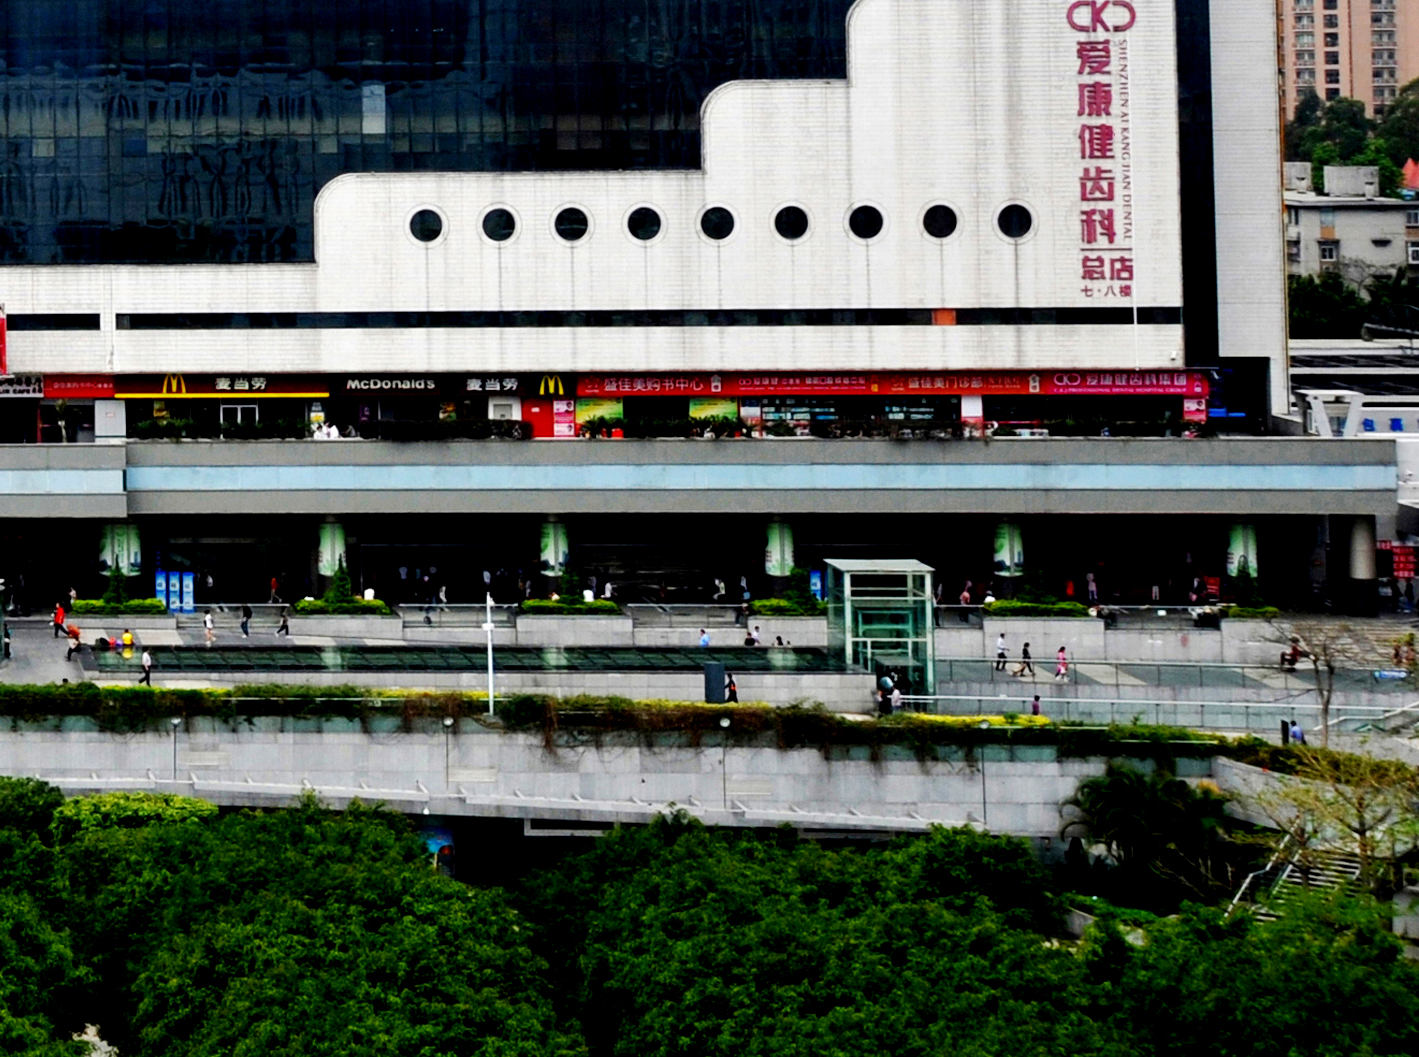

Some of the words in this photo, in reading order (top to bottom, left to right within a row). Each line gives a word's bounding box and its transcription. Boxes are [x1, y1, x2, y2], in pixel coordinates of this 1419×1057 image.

[1119, 39, 1129, 107] SHENZHEN
[1077, 39, 1116, 244] 爱康健齿科
[1122, 194, 1133, 240] DENTAL
[1081, 255, 1133, 280] 总店
[215, 377, 267, 391] 麦当劳
[346, 378, 436, 390] McDonald's
[466, 377, 519, 391] 麦当劳
